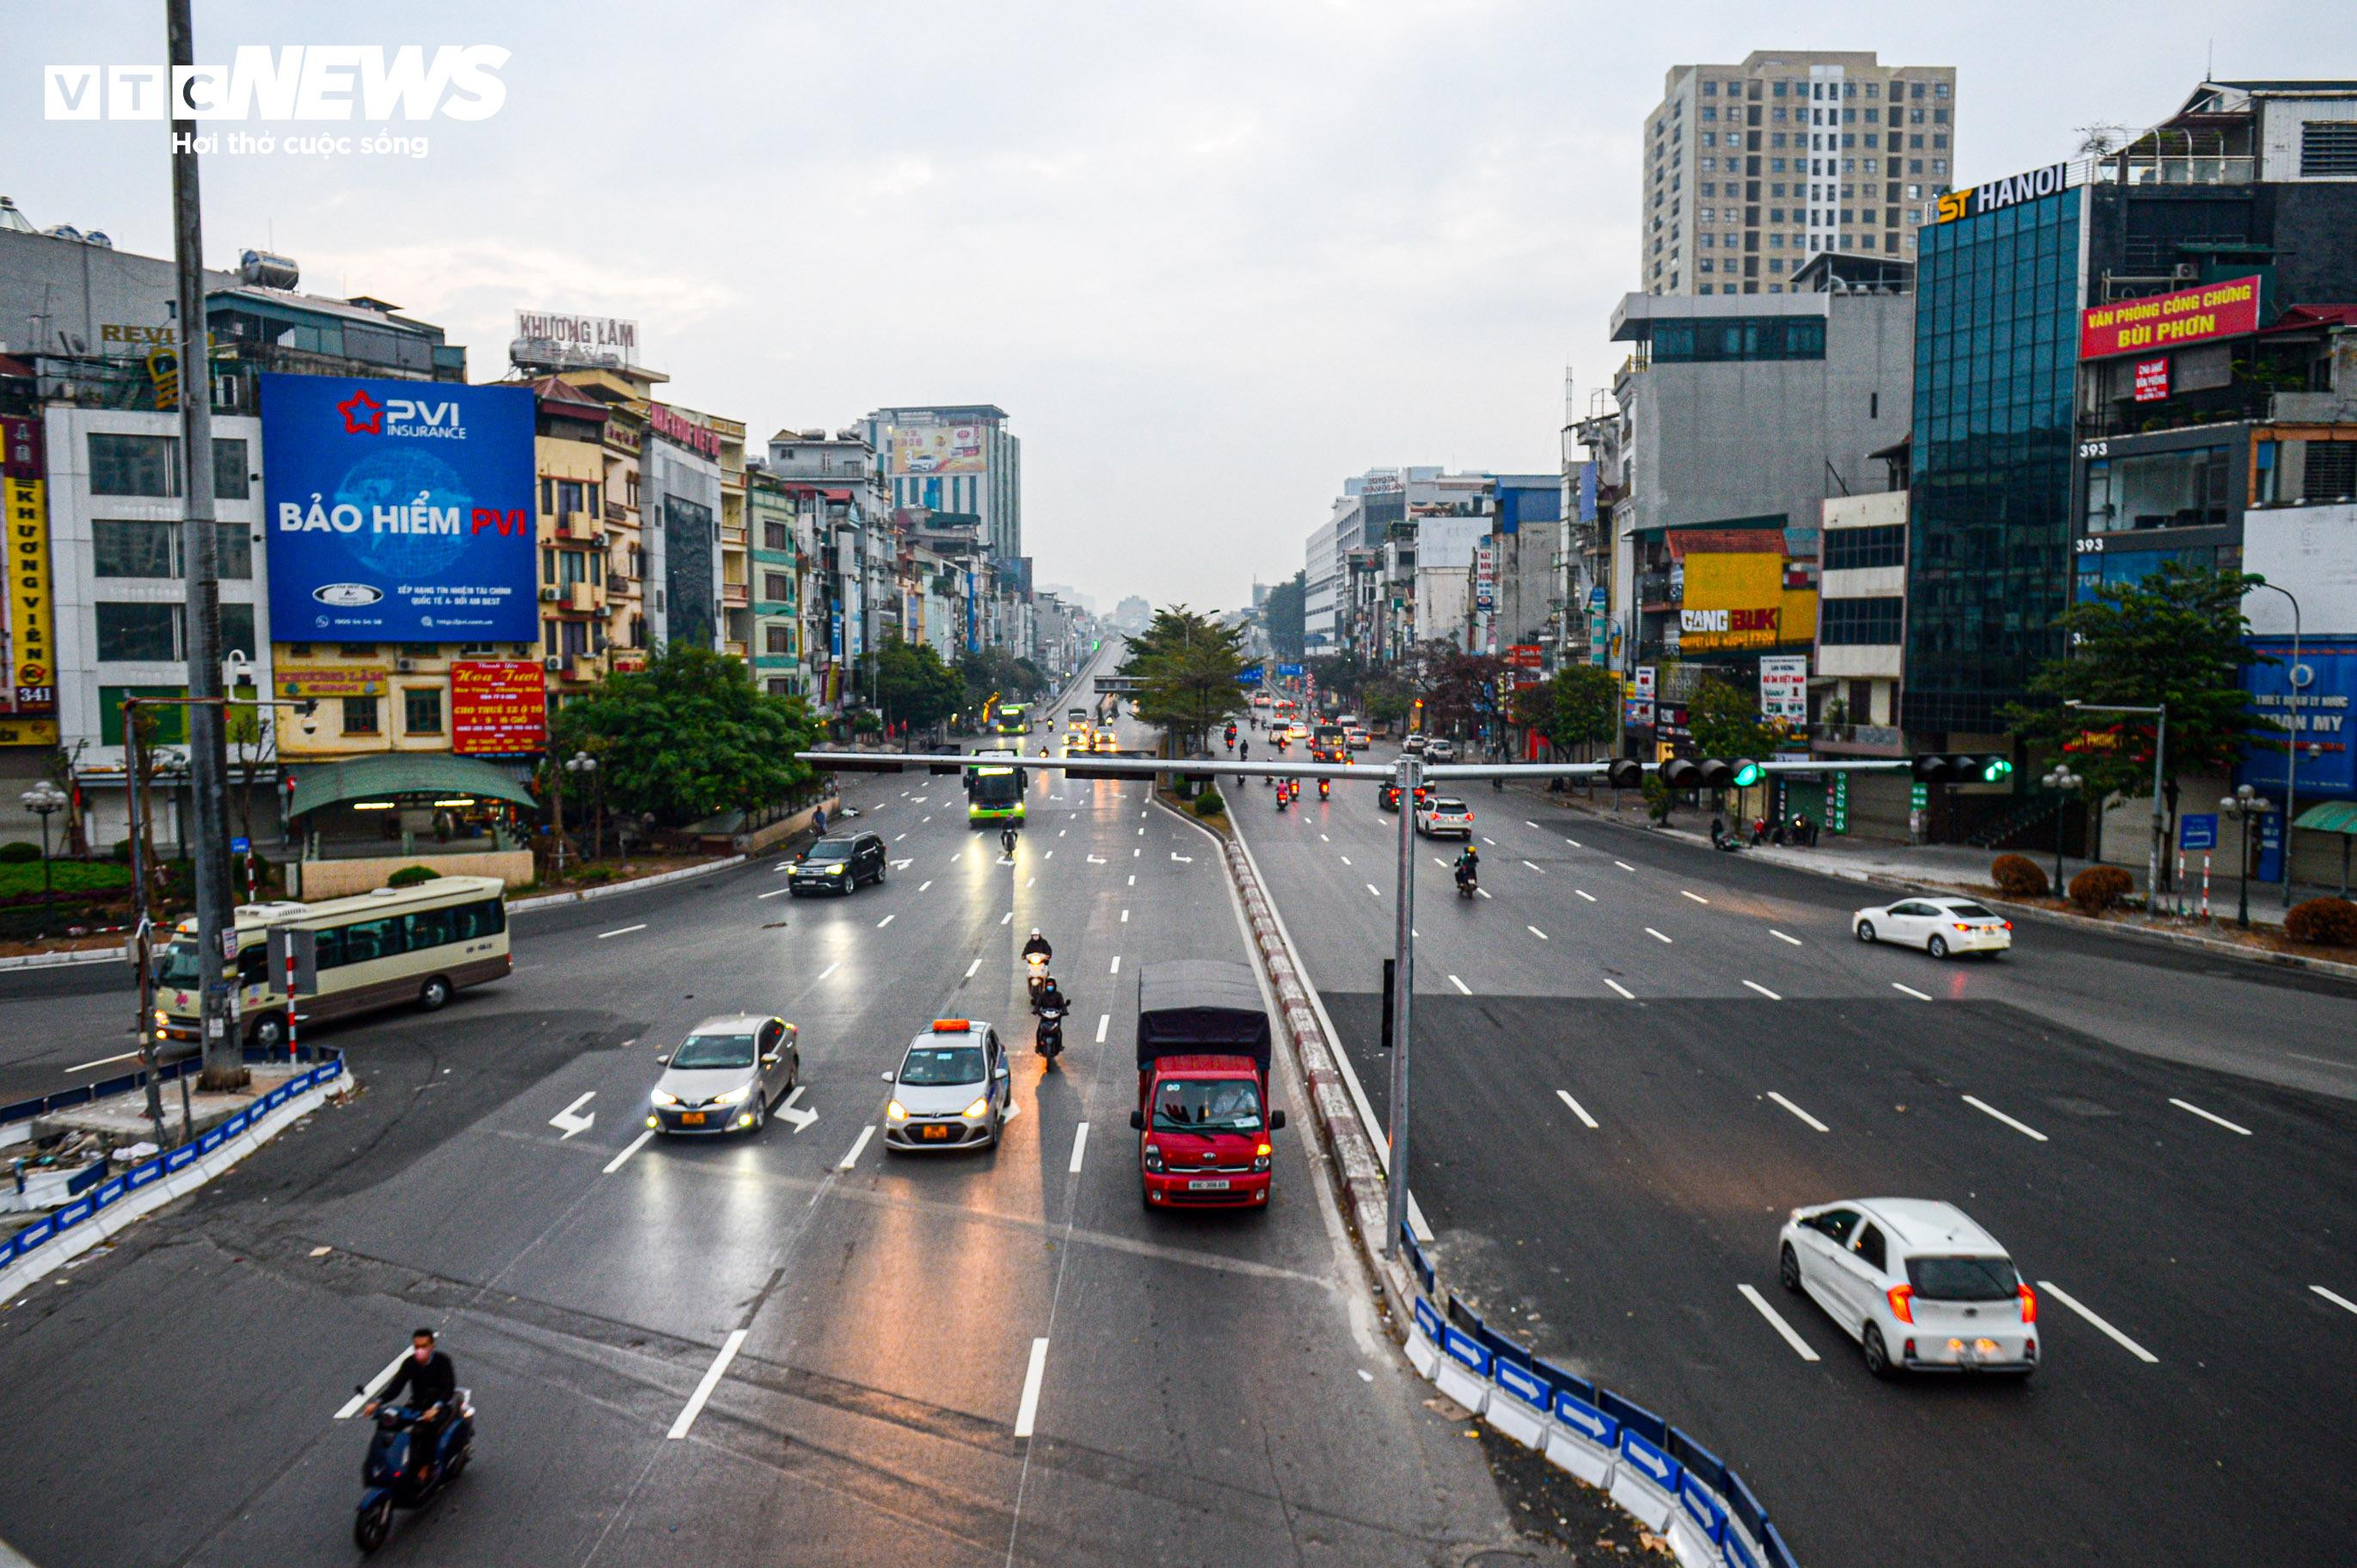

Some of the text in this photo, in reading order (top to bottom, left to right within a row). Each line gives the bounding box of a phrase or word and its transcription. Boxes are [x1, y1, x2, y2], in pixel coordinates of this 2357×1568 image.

[1978, 162, 2065, 213] HANOI
[2088, 285, 2252, 329] VĂN PHÒNG CÔNG CHỨNG
[519, 314, 635, 347] KHƯƠNG LÂM
[2117, 323, 2152, 348] BÙI
[386, 399, 460, 426] PVI
[387, 425, 467, 440] INSURANCE
[2079, 442, 2108, 458] 393
[279, 489, 526, 537] BẢO HIỂM PVI
[15, 489, 39, 589] KHƯƠNG
[2075, 537, 2104, 553] 393
[22, 596, 43, 660] VIÊN
[456, 669, 493, 683] Hoa
[20, 687, 52, 702] 341
